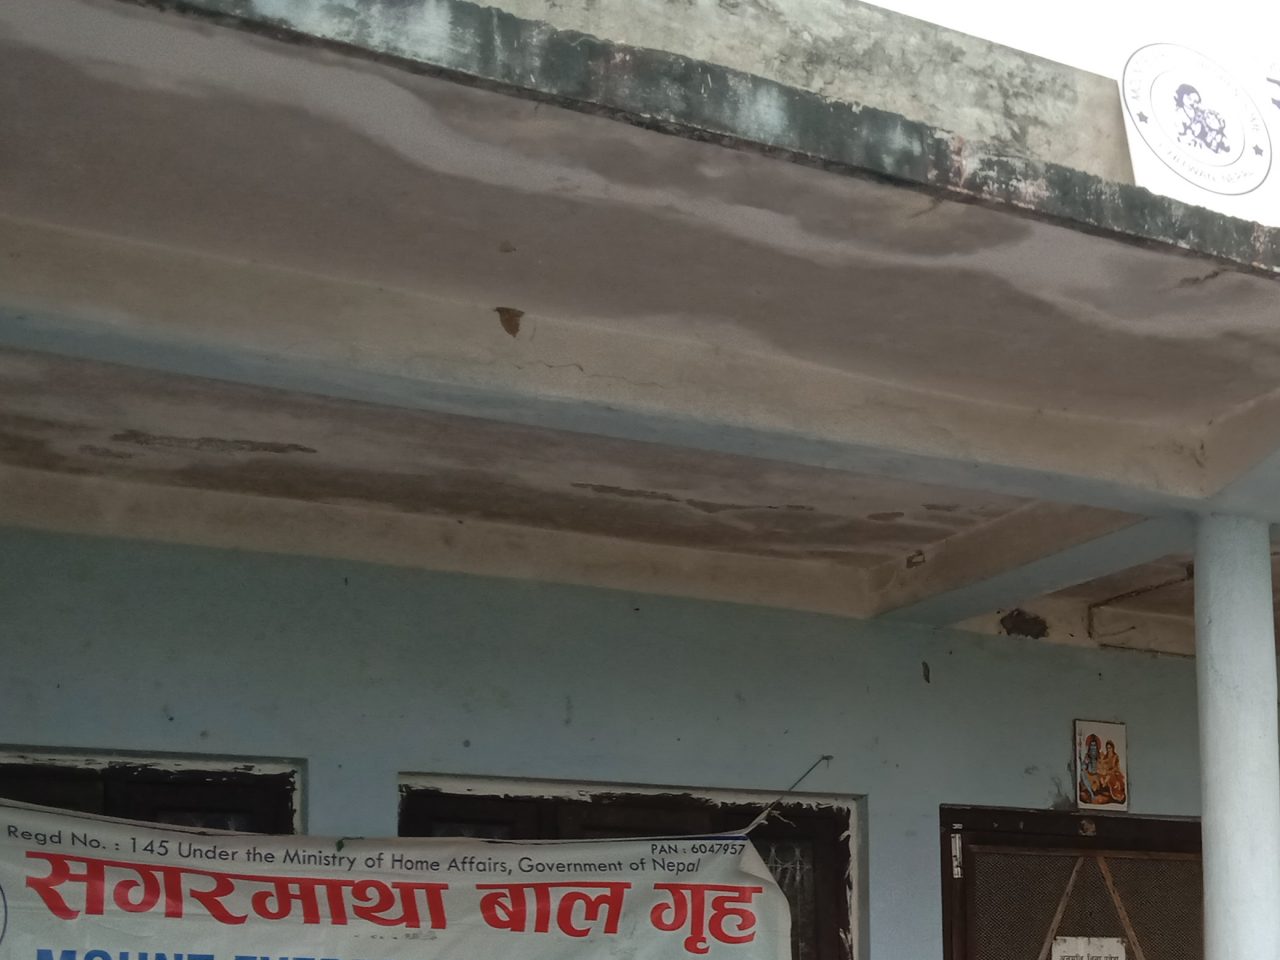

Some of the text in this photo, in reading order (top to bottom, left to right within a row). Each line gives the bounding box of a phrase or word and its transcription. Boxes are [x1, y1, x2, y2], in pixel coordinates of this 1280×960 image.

[7, 825, 62, 847] Regd
[71, 832, 107, 850] No.
[130, 837, 170, 857] 145
[178, 842, 239, 862] Under
[245, 847, 275, 864] the
[282, 849, 357, 873] Ministry
[364, 852, 385, 869] of
[391, 854, 441, 872] Home
[447, 857, 513, 876] Affairs,
[518, 856, 623, 873] Government
[629, 857, 647, 872] of
[652, 858, 701, 876] Nepal
[651, 843, 678, 856] PAN
[25, 850, 763, 955] सगरमाथा बाल गृह
